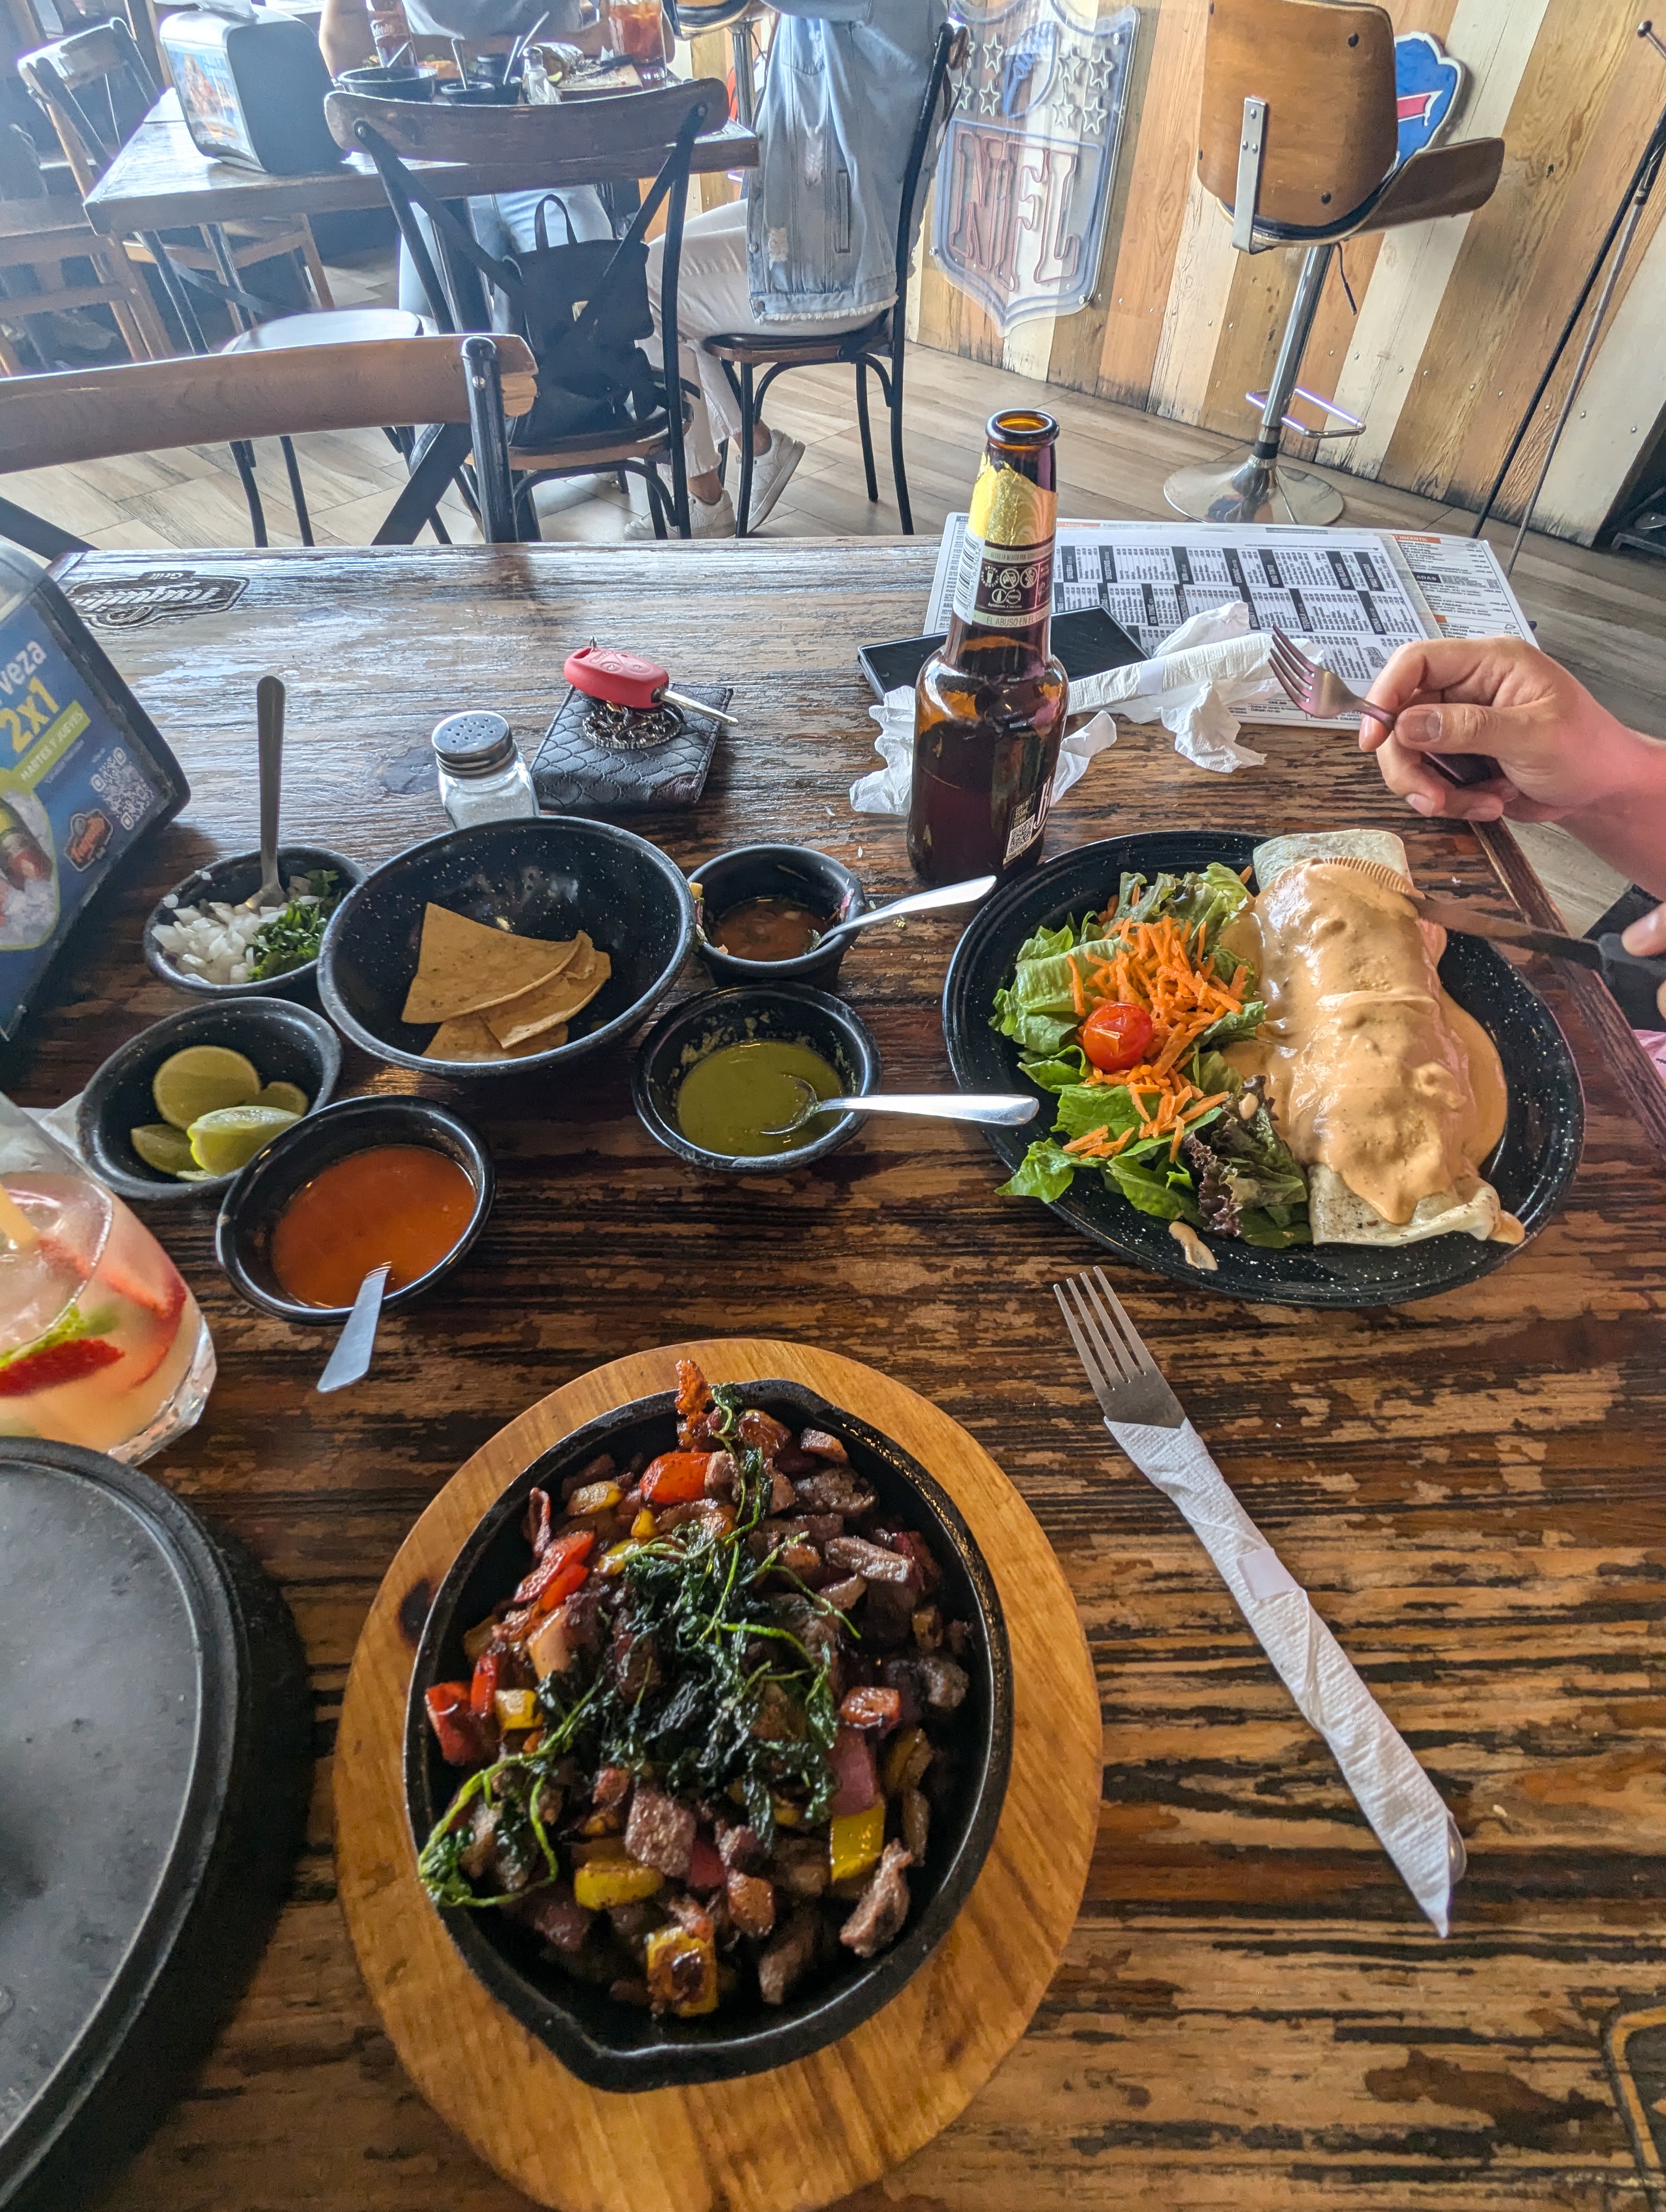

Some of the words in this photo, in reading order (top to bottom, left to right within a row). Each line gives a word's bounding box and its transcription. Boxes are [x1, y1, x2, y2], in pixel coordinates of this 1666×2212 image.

[948, 130, 1080, 291] NFL
[986, 616, 993, 624] EL
[995, 617, 1018, 626] ABUSO
[1019, 616, 1027, 625] EN
[1298, 613, 1312, 629] TEQUILA
[0, 641, 47, 695] veza
